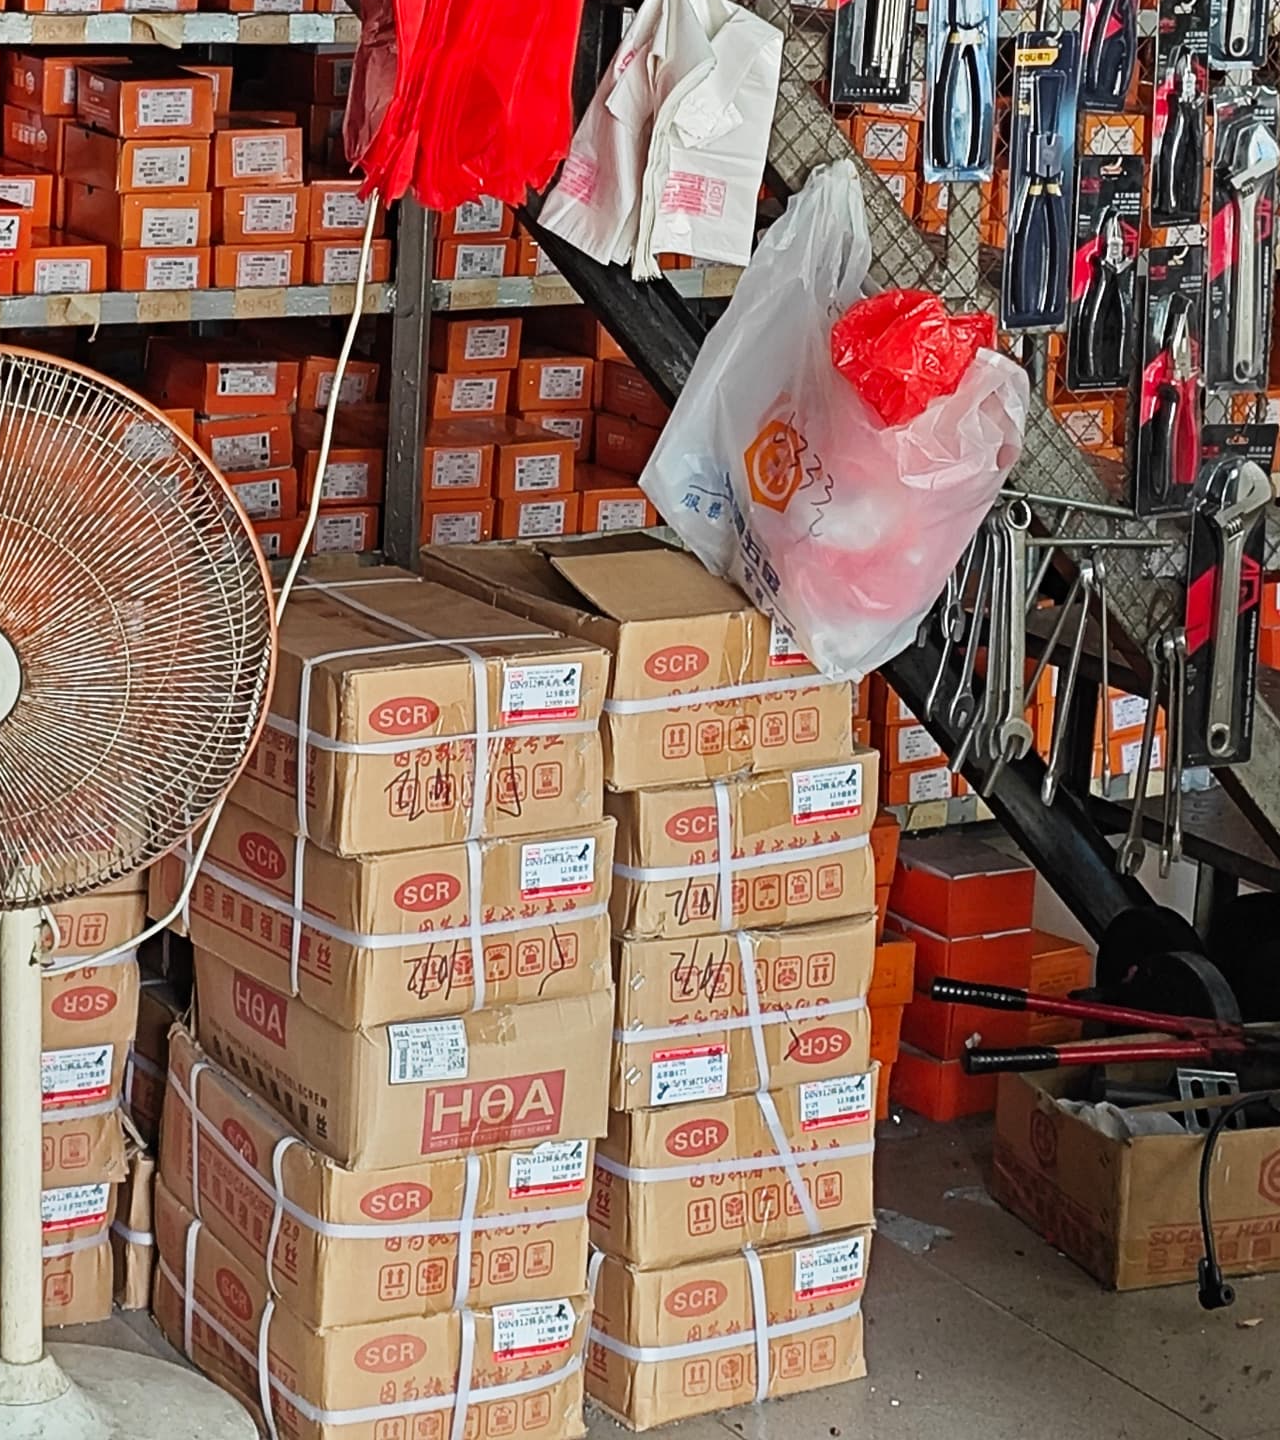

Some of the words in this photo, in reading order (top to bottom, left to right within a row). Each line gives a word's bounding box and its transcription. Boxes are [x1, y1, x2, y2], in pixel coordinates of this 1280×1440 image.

[653, 653, 699, 676] SCR
[378, 707, 428, 729] SCR
[244, 840, 279, 874] SCR
[402, 880, 451, 906] SCR
[62, 991, 110, 1015] SCR
[798, 1033, 843, 1054] SCR
[673, 1127, 719, 1151] SCR
[370, 1190, 421, 1214] SCR
[672, 1289, 719, 1311] SCR
[364, 1342, 415, 1366] SCR
